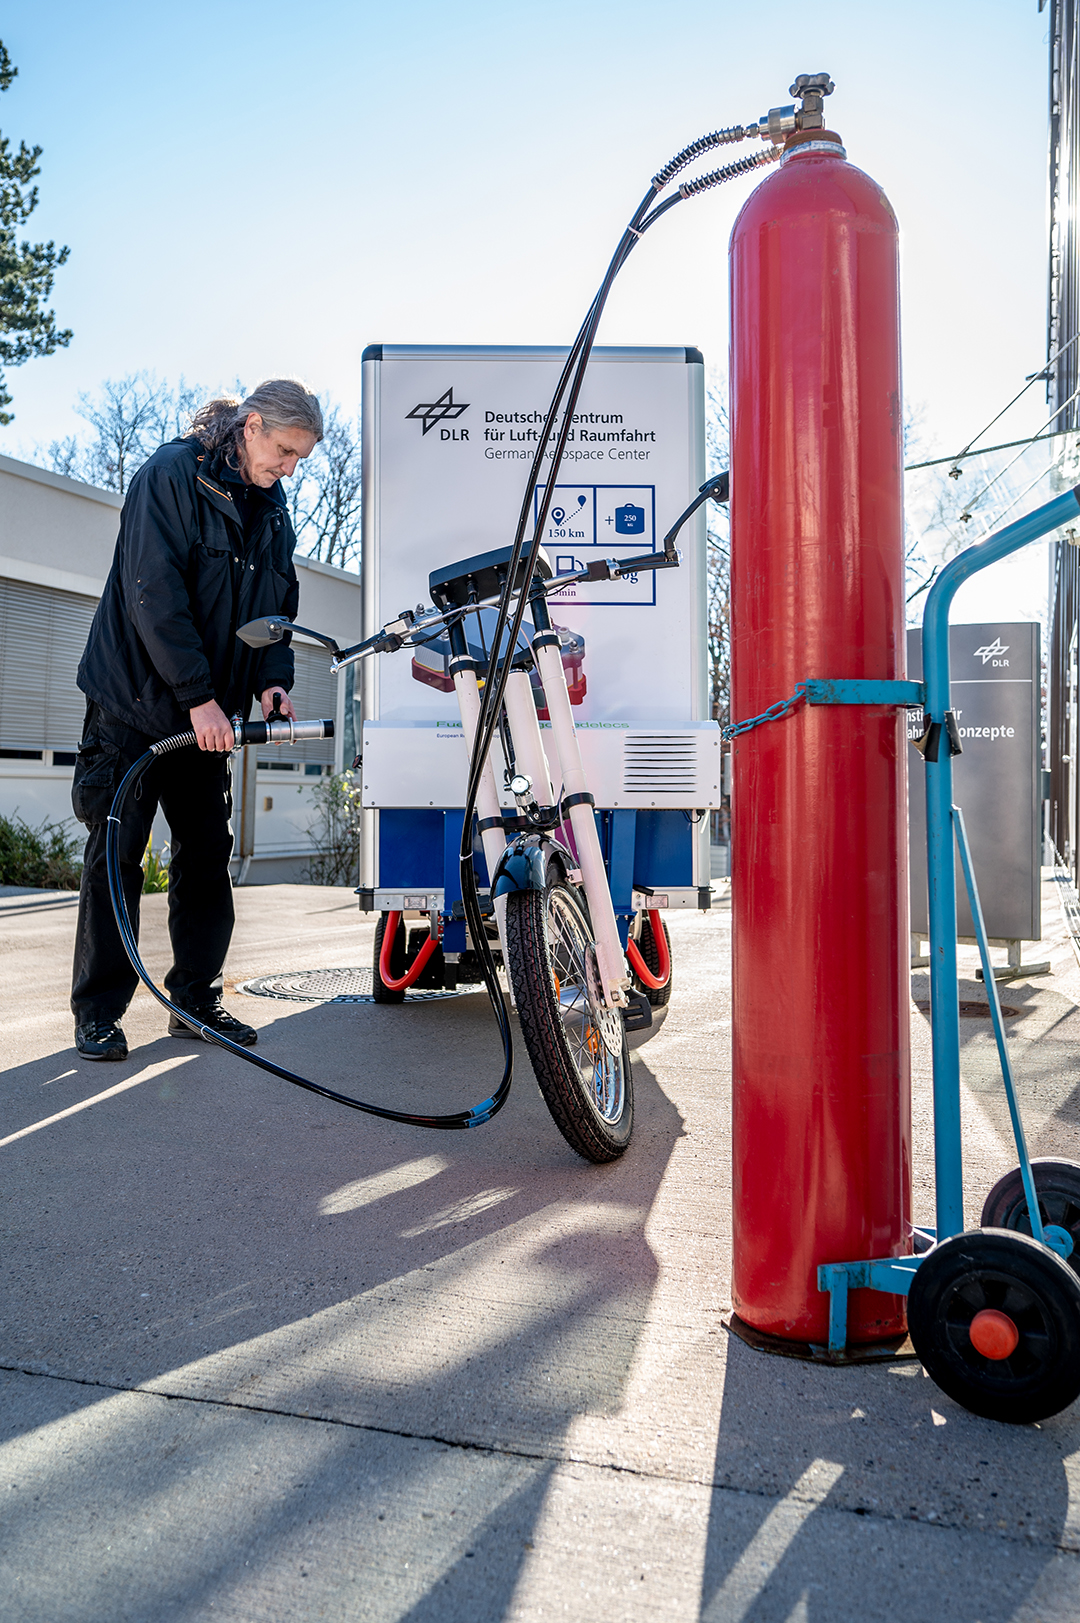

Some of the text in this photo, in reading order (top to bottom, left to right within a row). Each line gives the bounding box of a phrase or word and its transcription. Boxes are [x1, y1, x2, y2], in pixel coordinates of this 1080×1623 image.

[484, 410, 624, 424] Deutsches entrum
[440, 428, 470, 441] DLR
[484, 427, 506, 441] für
[509, 428, 541, 441] Luft-
[579, 428, 656, 442] Raumfahrt
[484, 446, 651, 463] German Aeospace Center
[624, 514, 637, 522] 250
[548, 528, 585, 538] 150 km
[992, 659, 1010, 667] DLR
[436, 720, 630, 729] Fue edelecs
